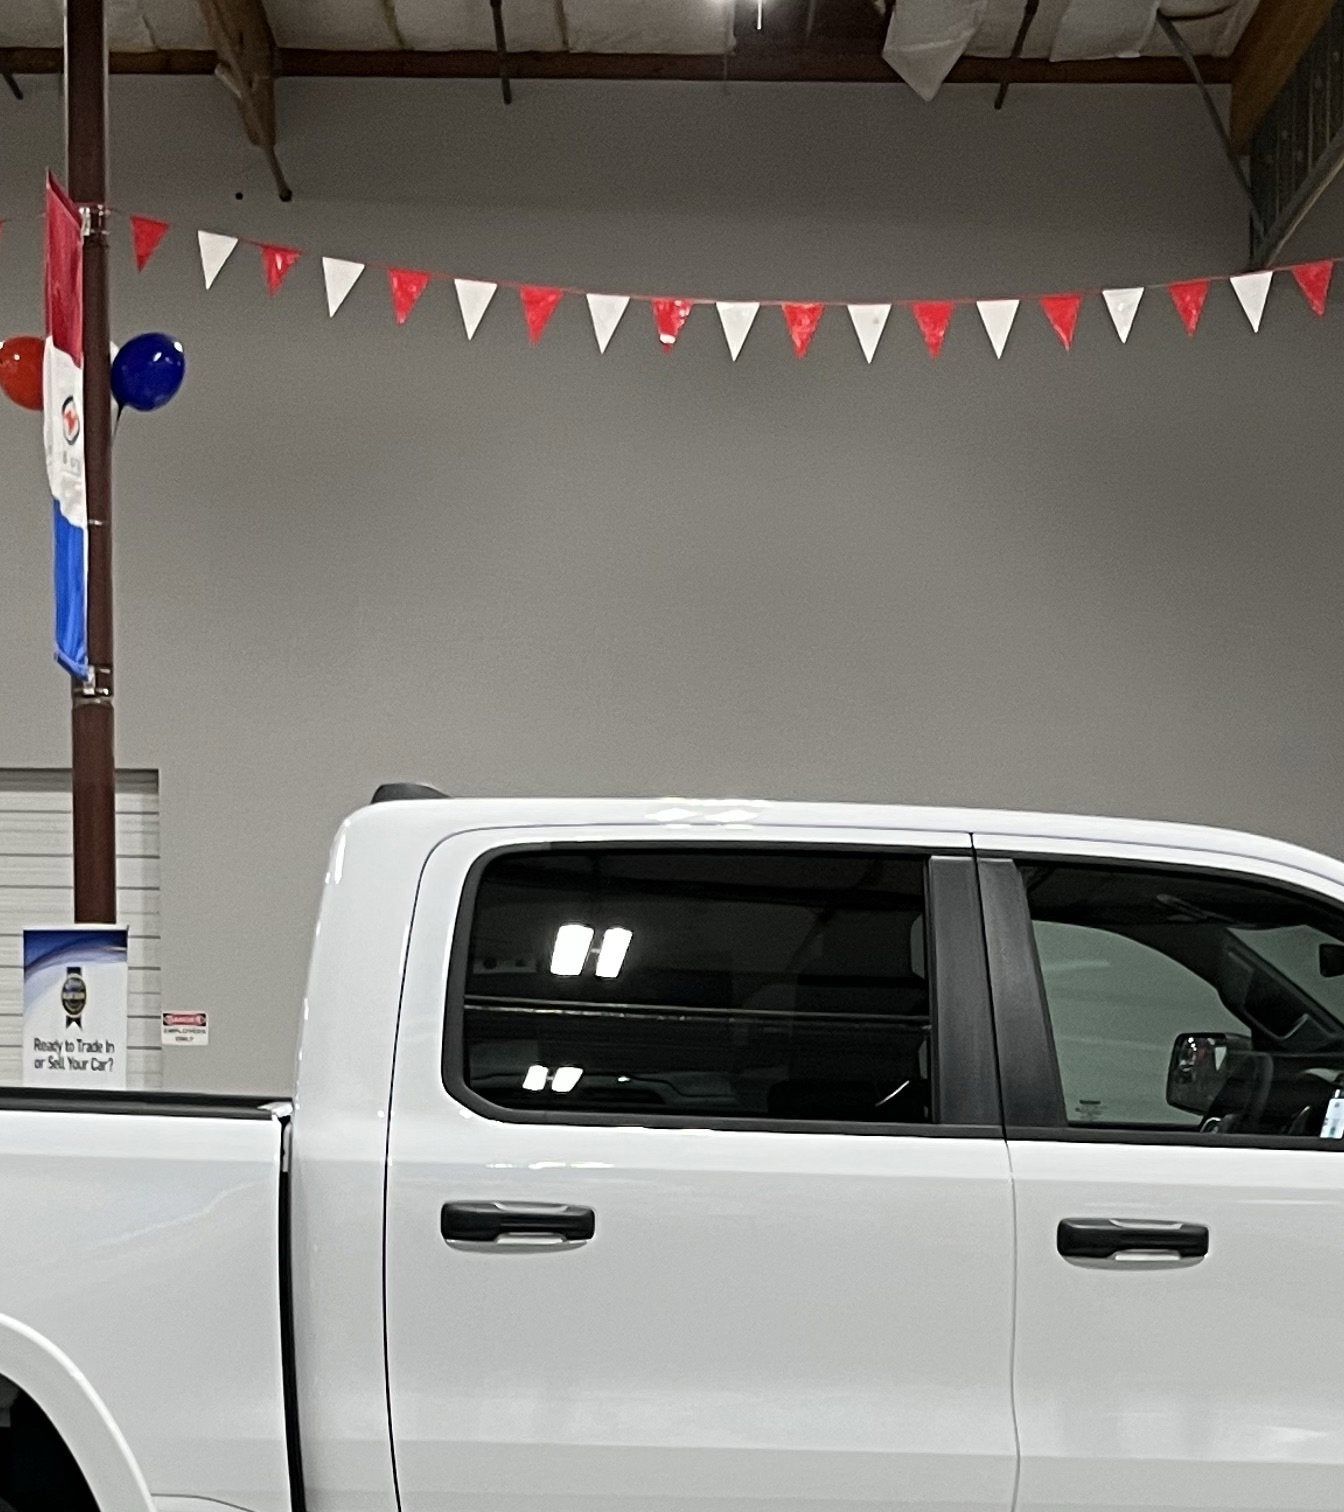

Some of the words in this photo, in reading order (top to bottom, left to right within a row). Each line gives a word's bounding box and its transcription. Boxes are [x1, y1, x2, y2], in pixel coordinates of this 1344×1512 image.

[34, 1037, 62, 1056] Ready
[65, 1040, 75, 1053] to
[76, 1038, 103, 1053] Trade
[34, 1058, 46, 1069] or
[48, 1055, 66, 1071] Sell
[67, 1056, 89, 1071] Your
[91, 1057, 114, 1073] Car?
